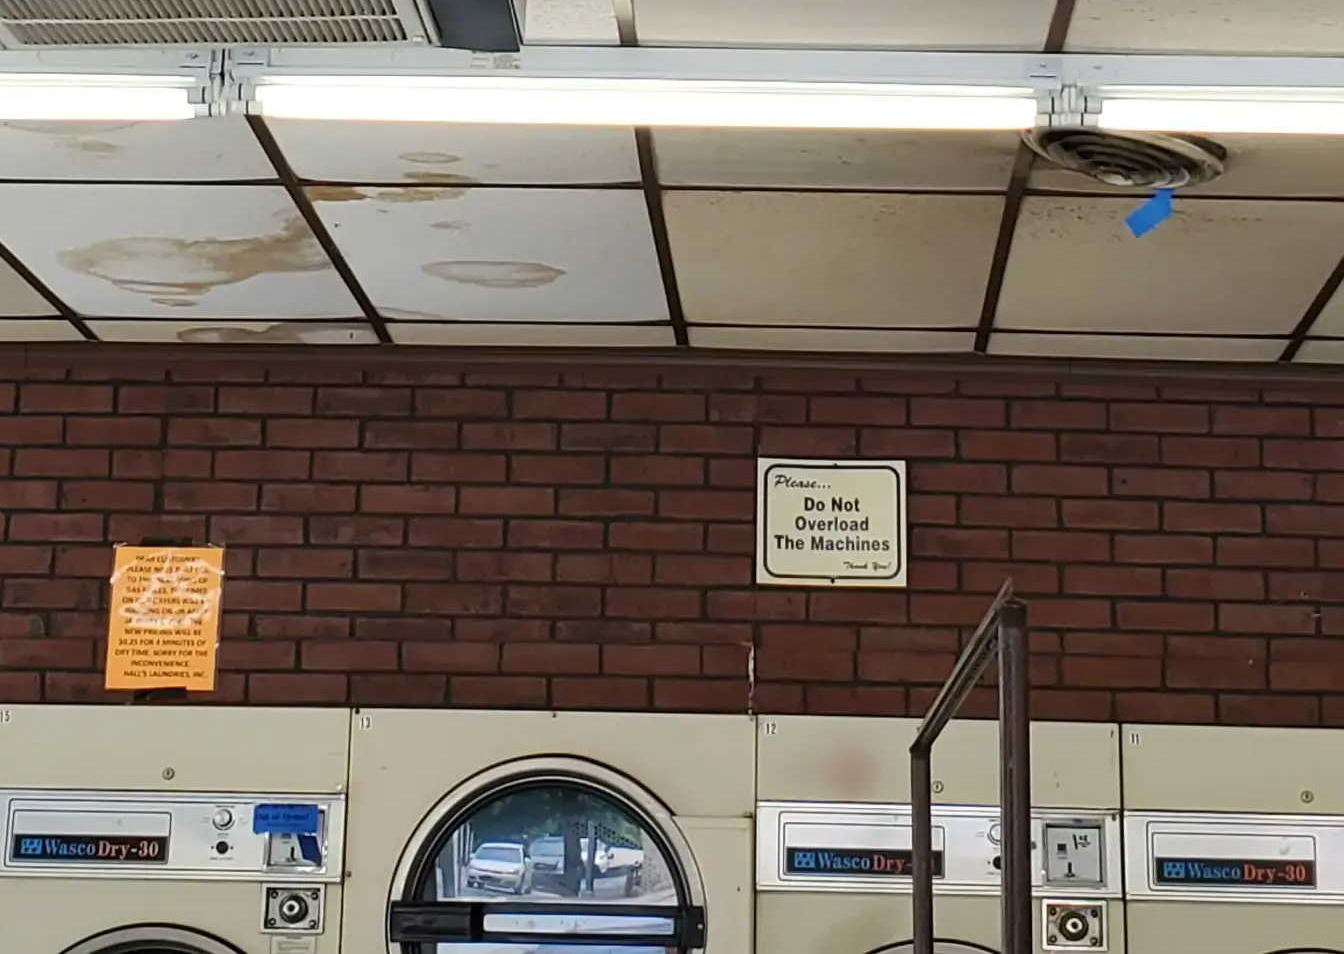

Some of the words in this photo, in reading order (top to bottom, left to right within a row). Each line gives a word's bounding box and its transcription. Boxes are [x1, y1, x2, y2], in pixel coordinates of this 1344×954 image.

[774, 475, 831, 489] Please...
[804, 497, 825, 511] Do
[831, 497, 860, 512] Not
[795, 516, 869, 531] Overload
[774, 535, 805, 550] The
[811, 536, 890, 551] Machines
[843, 561, 868, 570] Thank
[872, 562, 891, 571] You!
[766, 723, 776, 734] 12
[44, 838, 97, 855] Wasco
[818, 851, 871, 870] Wasco
[872, 854, 913, 874] Dry-
[1188, 861, 1241, 879] Wasco
